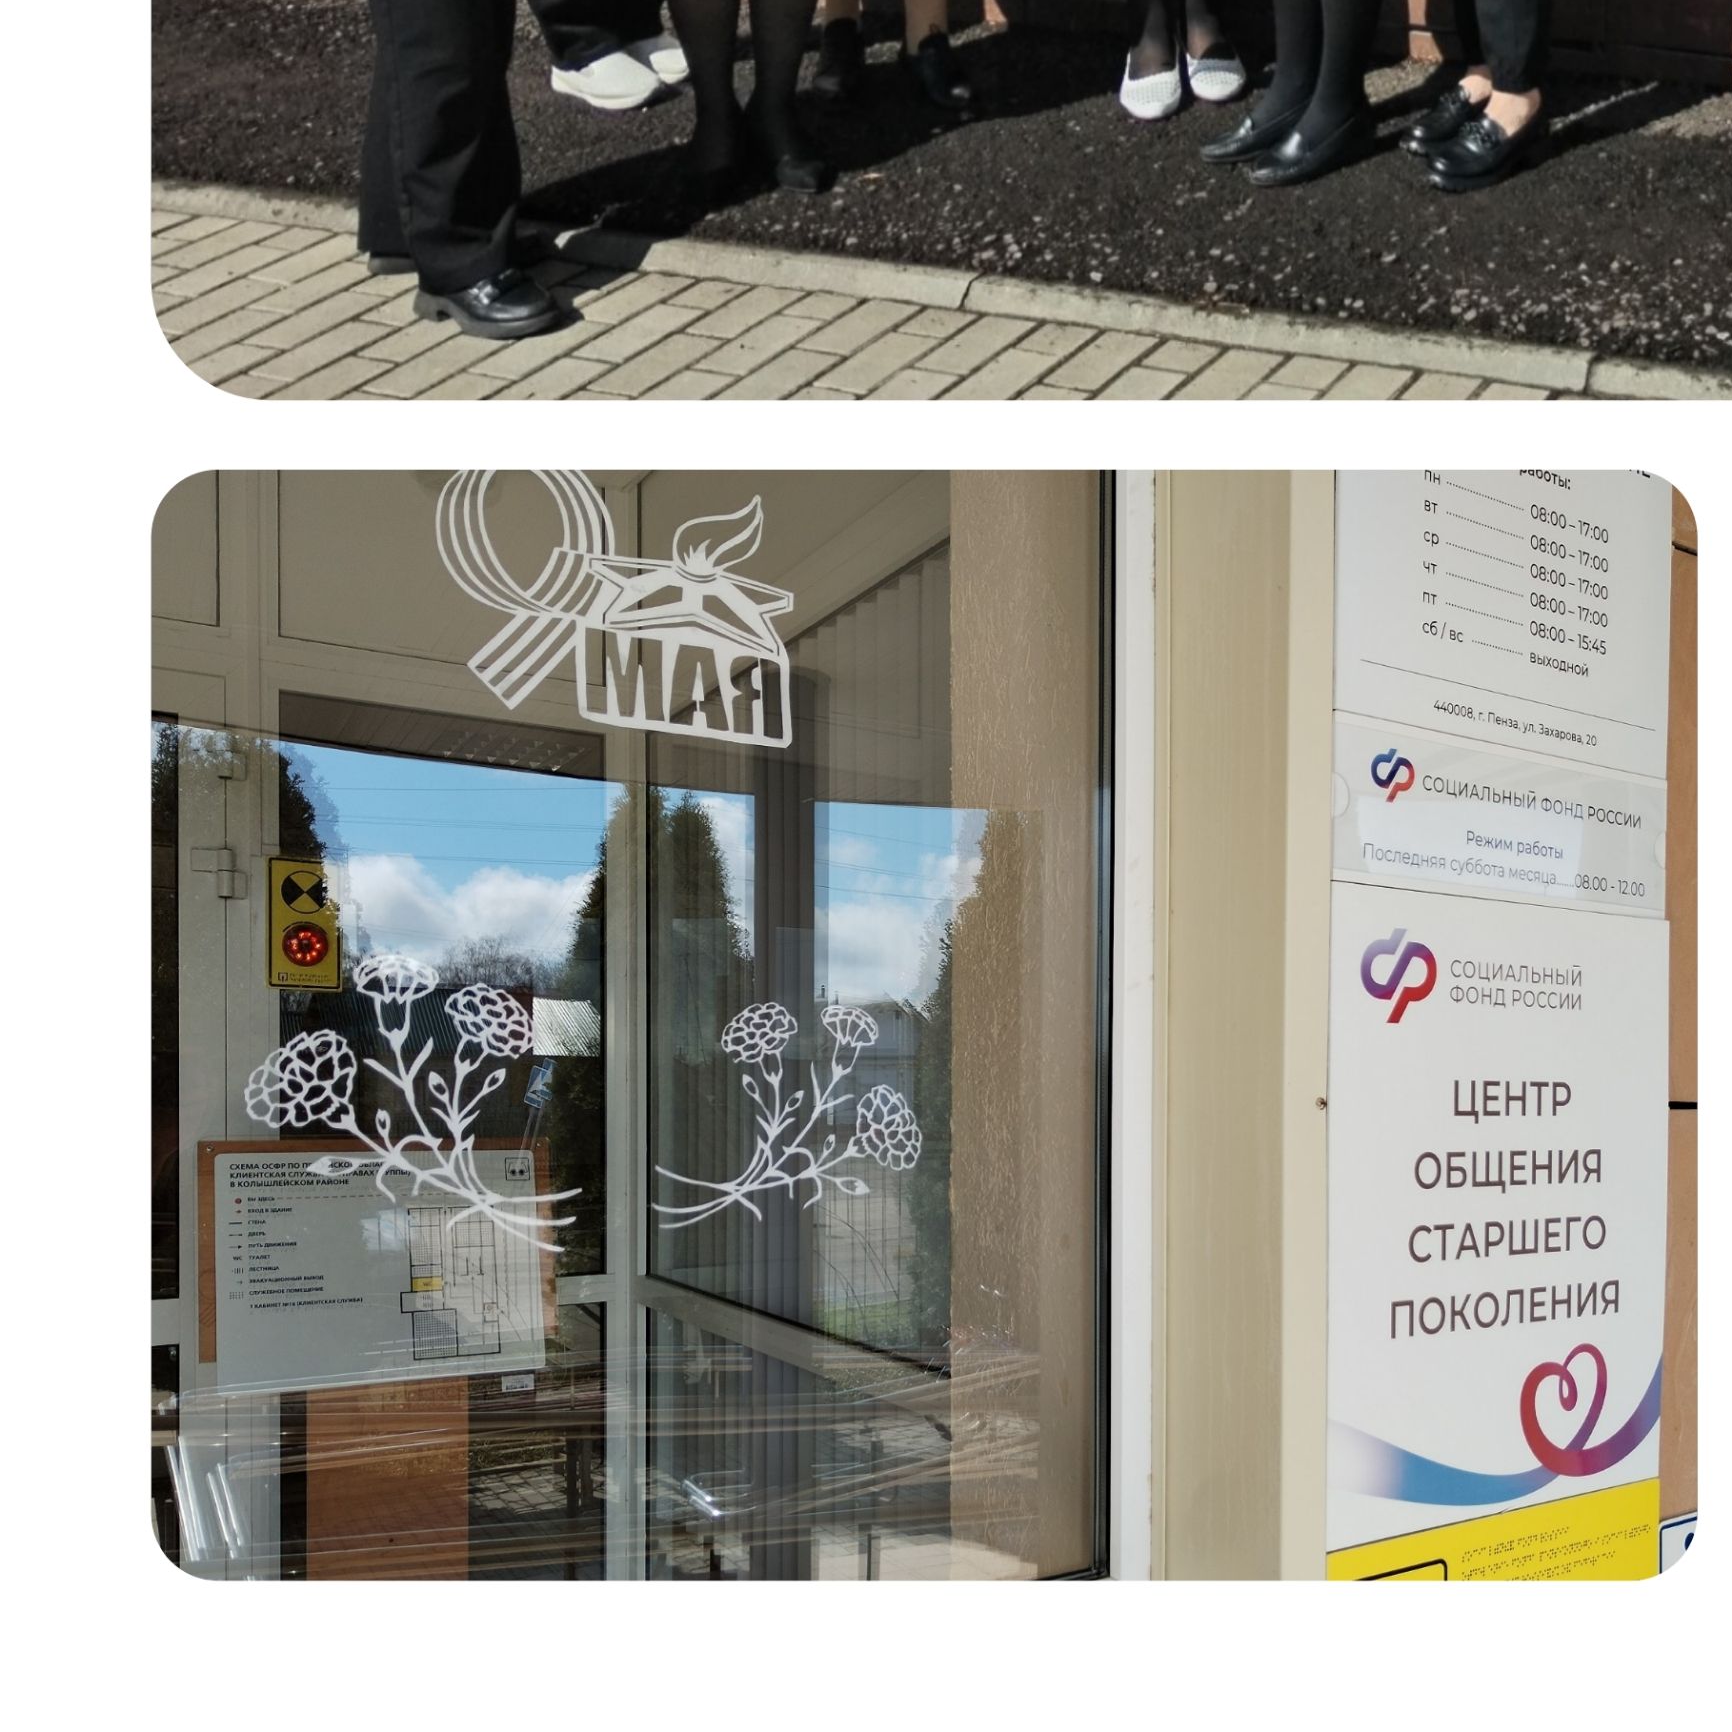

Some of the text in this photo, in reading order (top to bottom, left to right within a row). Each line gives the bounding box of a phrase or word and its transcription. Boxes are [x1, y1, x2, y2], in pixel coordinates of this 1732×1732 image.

[1424, 470, 1441, 486] пн
[1530, 504, 1567, 529] 08:00
[1578, 519, 1609, 543] 17:00
[1424, 499, 1439, 515] вт
[1530, 534, 1567, 559] 08:00
[1578, 549, 1609, 573] 17:00
[1423, 530, 1440, 548] ср
[1530, 563, 1567, 588] 08:00
[1578, 577, 1609, 601] 17:00
[1423, 560, 1438, 575] чт
[1530, 592, 1567, 616] 08:00
[1578, 605, 1609, 628] 17:00
[1423, 591, 1437, 606] пт
[1530, 620, 1567, 644] 08:00
[1578, 633, 1607, 656] 15:45
[1422, 620, 1438, 637] сб
[1450, 629, 1464, 644] вс
[1529, 651, 1589, 677] выходной
[585, 627, 785, 740] МАЯ
[1433, 700, 1597, 747] 440008, г. Пенза, ул. Захарова, 20
[1423, 774, 1641, 829] СОЦИАЛЬНЫЙ ФОНД РОССИИ
[1363, 843, 1446, 869] Последняя
[1450, 858, 1505, 878] суббота
[1466, 831, 1563, 860] Режим работы
[1450, 959, 1582, 987] СОЦИАЛЬНЫЙ
[1449, 985, 1582, 1010] ФОНД РОССИИ
[1453, 1079, 1572, 1124] ЦЕНТР
[229, 1171, 286, 1179] КЛИЕНТСКАЯ
[237, 1179, 314, 1188] КОЛЫШЛЕЙСКОМ
[316, 1178, 350, 1186] РАЙОНЕ
[262, 1162, 286, 1170] ОСФР
[1414, 1149, 1601, 1194] ОБЩЕНИЯ
[1408, 1215, 1607, 1263] СТАРШЕГО
[1390, 1279, 1620, 1339] ПОКОЛЕНИЯ
